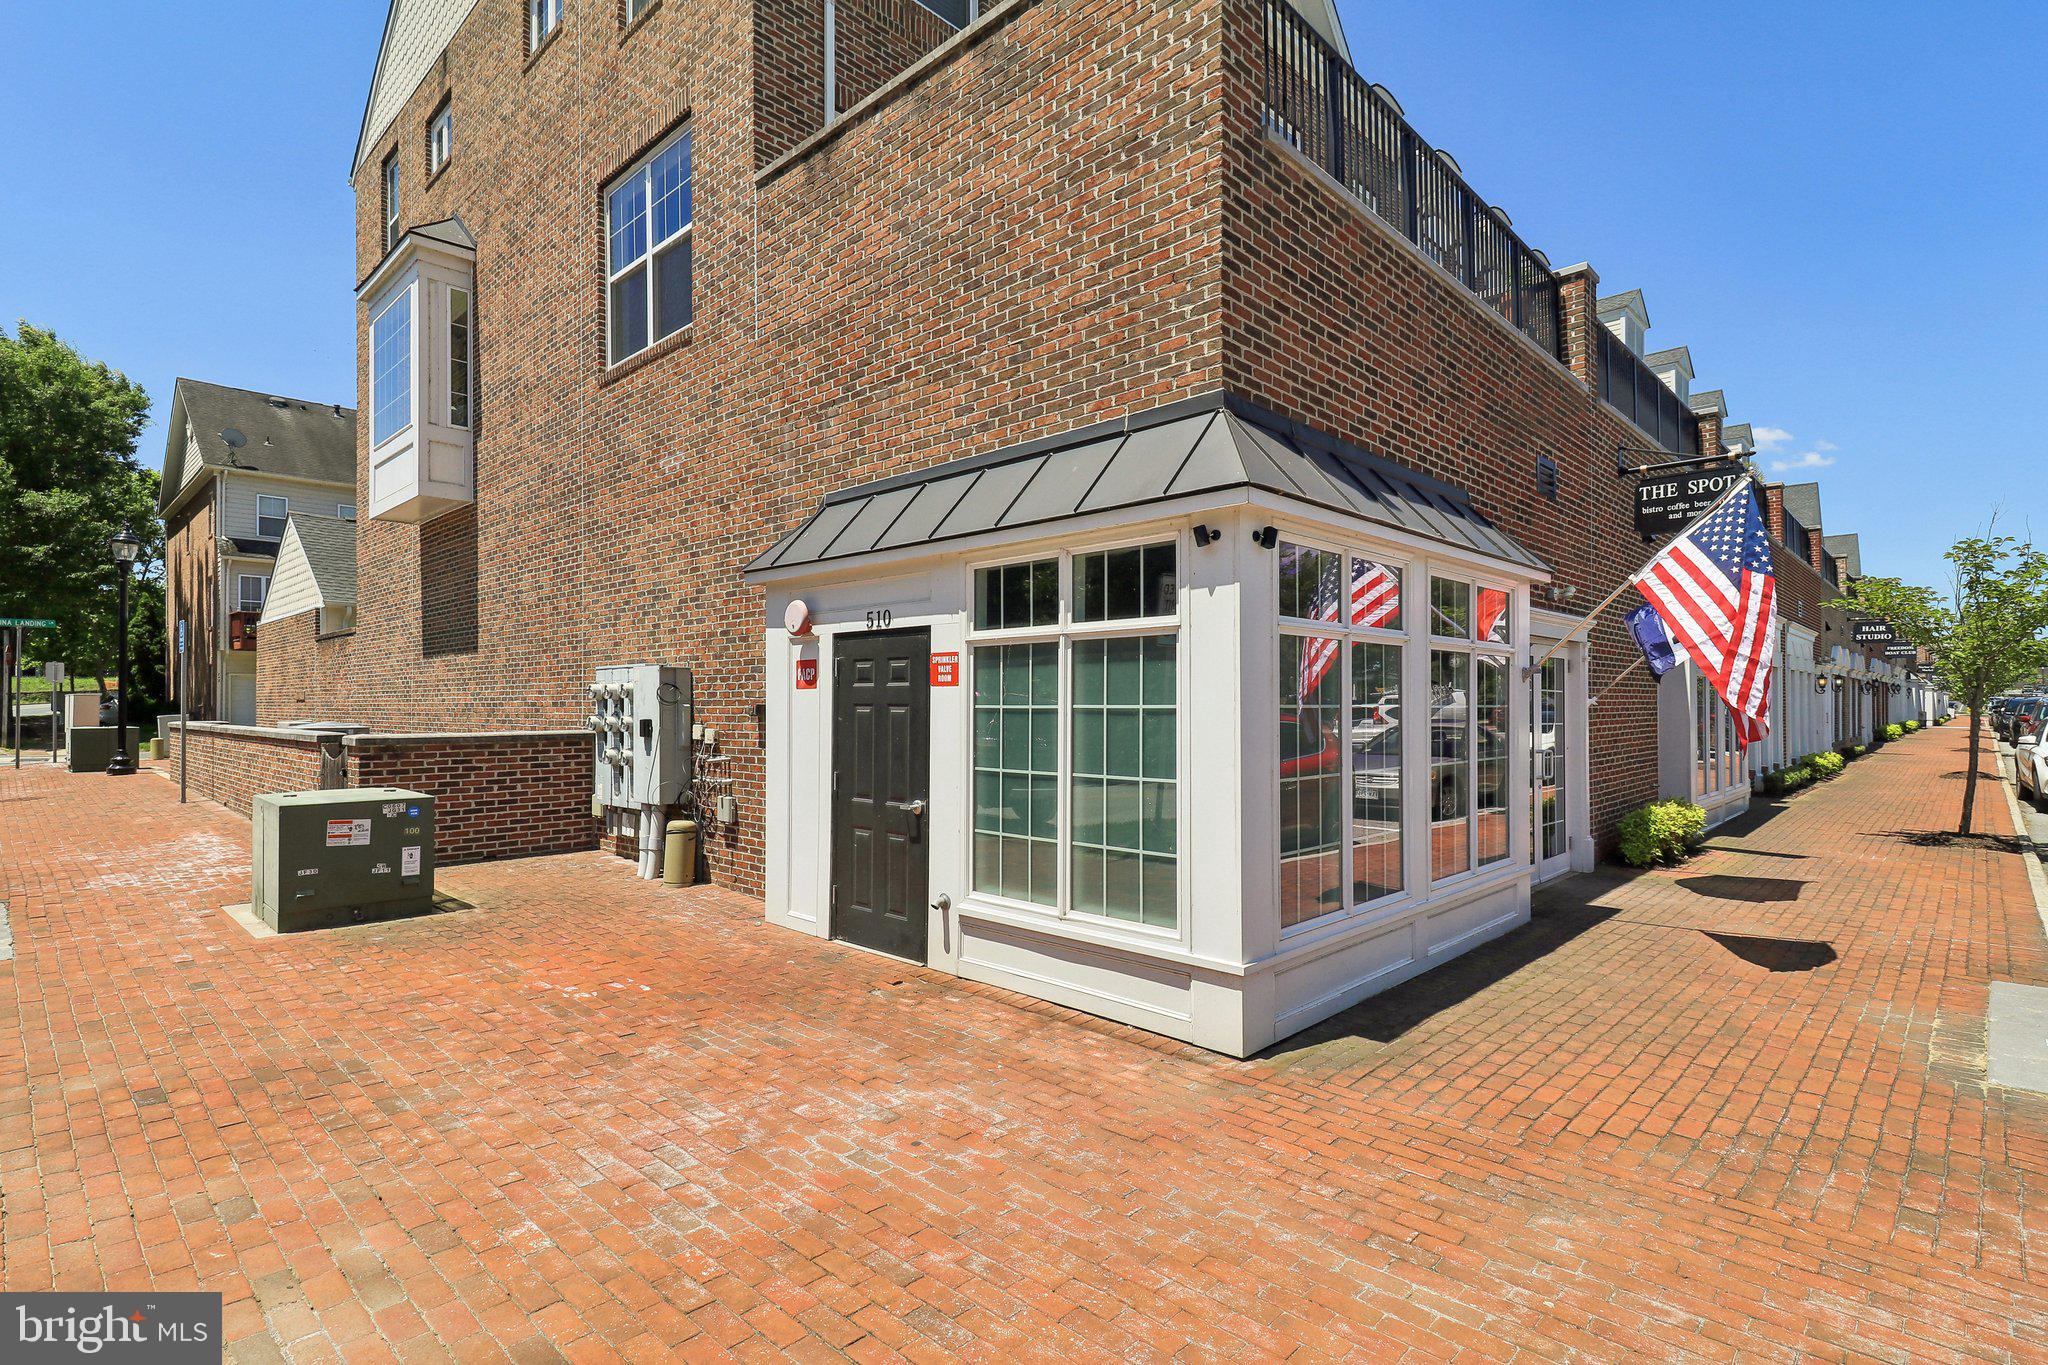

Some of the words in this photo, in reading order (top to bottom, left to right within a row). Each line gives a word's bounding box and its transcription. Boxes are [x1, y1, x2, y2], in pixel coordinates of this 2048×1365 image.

[1639, 483, 1678, 501] THE
[1688, 475, 1736, 495] SPOT
[1642, 505, 1663, 514] bistro
[1667, 502, 1690, 511] coffee
[1694, 500, 1712, 508] beer
[1687, 510, 1703, 518] mor
[866, 609, 892, 630] 510
[931, 655, 959, 664] SPRINKLER
[797, 667, 815, 681] FACP
[937, 664, 952, 673] VALVE
[937, 674, 952, 682] ROOM
